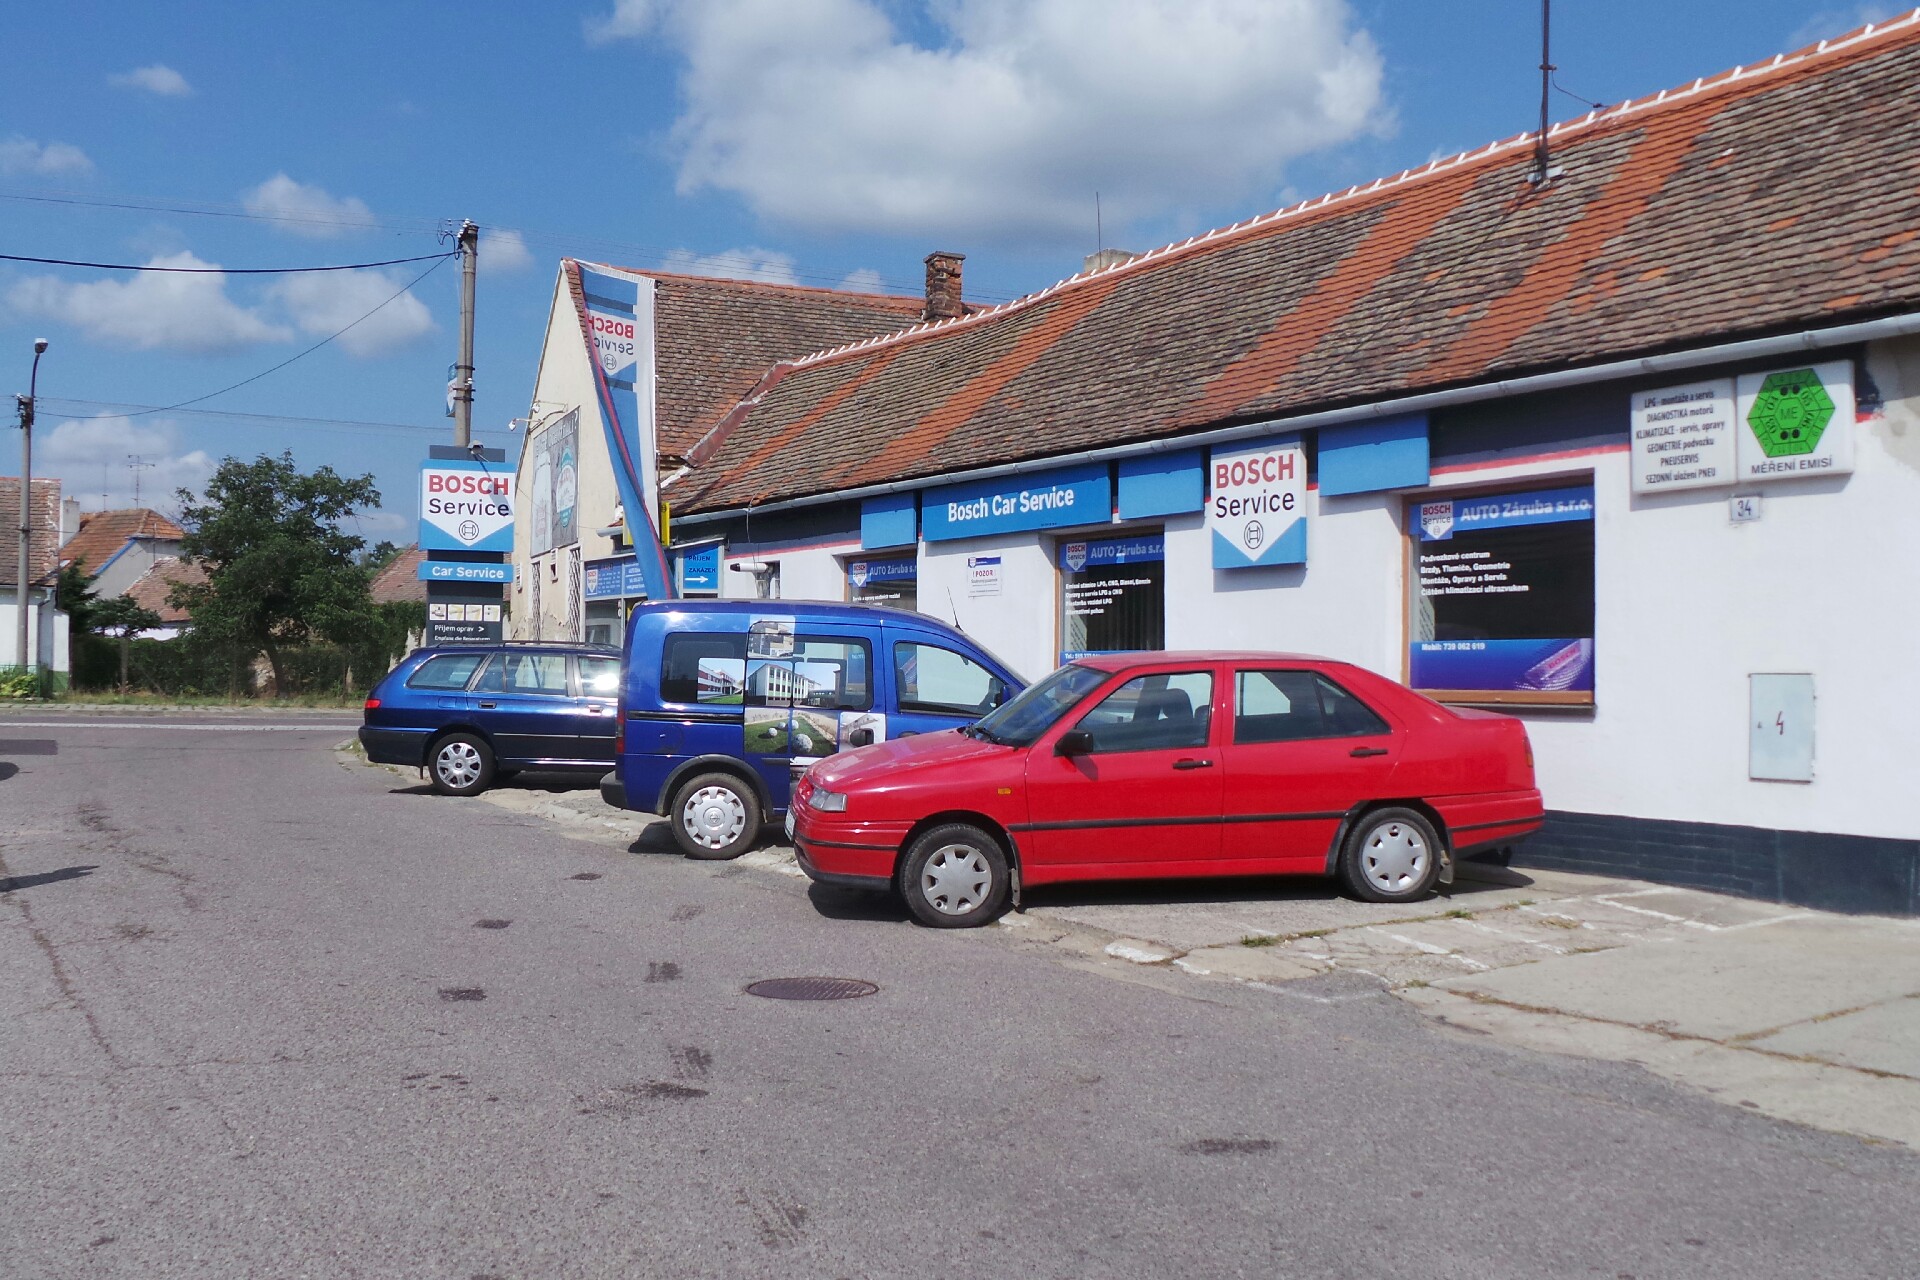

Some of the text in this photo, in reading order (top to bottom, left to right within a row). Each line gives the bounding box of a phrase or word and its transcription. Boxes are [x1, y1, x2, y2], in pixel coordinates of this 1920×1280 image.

[1647, 408, 1688, 423] DIAGNOSTIKA
[1636, 425, 1674, 439] KLIMATIZACE
[1702, 421, 1725, 432] opravy
[1647, 437, 1715, 453] GEOMETRIE podvozku
[1660, 453, 1699, 467] PNEUSERVIS
[1751, 454, 1832, 473] MĚŘENÍ EMISÍ
[1216, 453, 1294, 488] BOSCH
[1698, 467, 1716, 477] PNEU
[429, 474, 509, 495] BOSCH
[429, 498, 510, 516] Service
[948, 486, 1074, 522] Bosch Car Service
[1216, 489, 1294, 518] Service
[1422, 504, 1451, 515] BOSCH
[1460, 498, 1593, 521] AUTO Záruba s.r.o.
[1737, 498, 1752, 517] 34
[1422, 516, 1451, 525] Service
[1067, 544, 1086, 553] BOSCH
[1091, 547, 1115, 558] AUTO
[1116, 543, 1147, 556] Záruba
[432, 566, 504, 579] Car Service
[870, 566, 887, 576] AUTO
[887, 564, 909, 575] Záruba
[1472, 562, 1511, 571] Geometrie
[1452, 575, 1477, 584] Opravy
[1484, 573, 1507, 581] Servis
[1484, 585, 1529, 593] ultrazvukem
